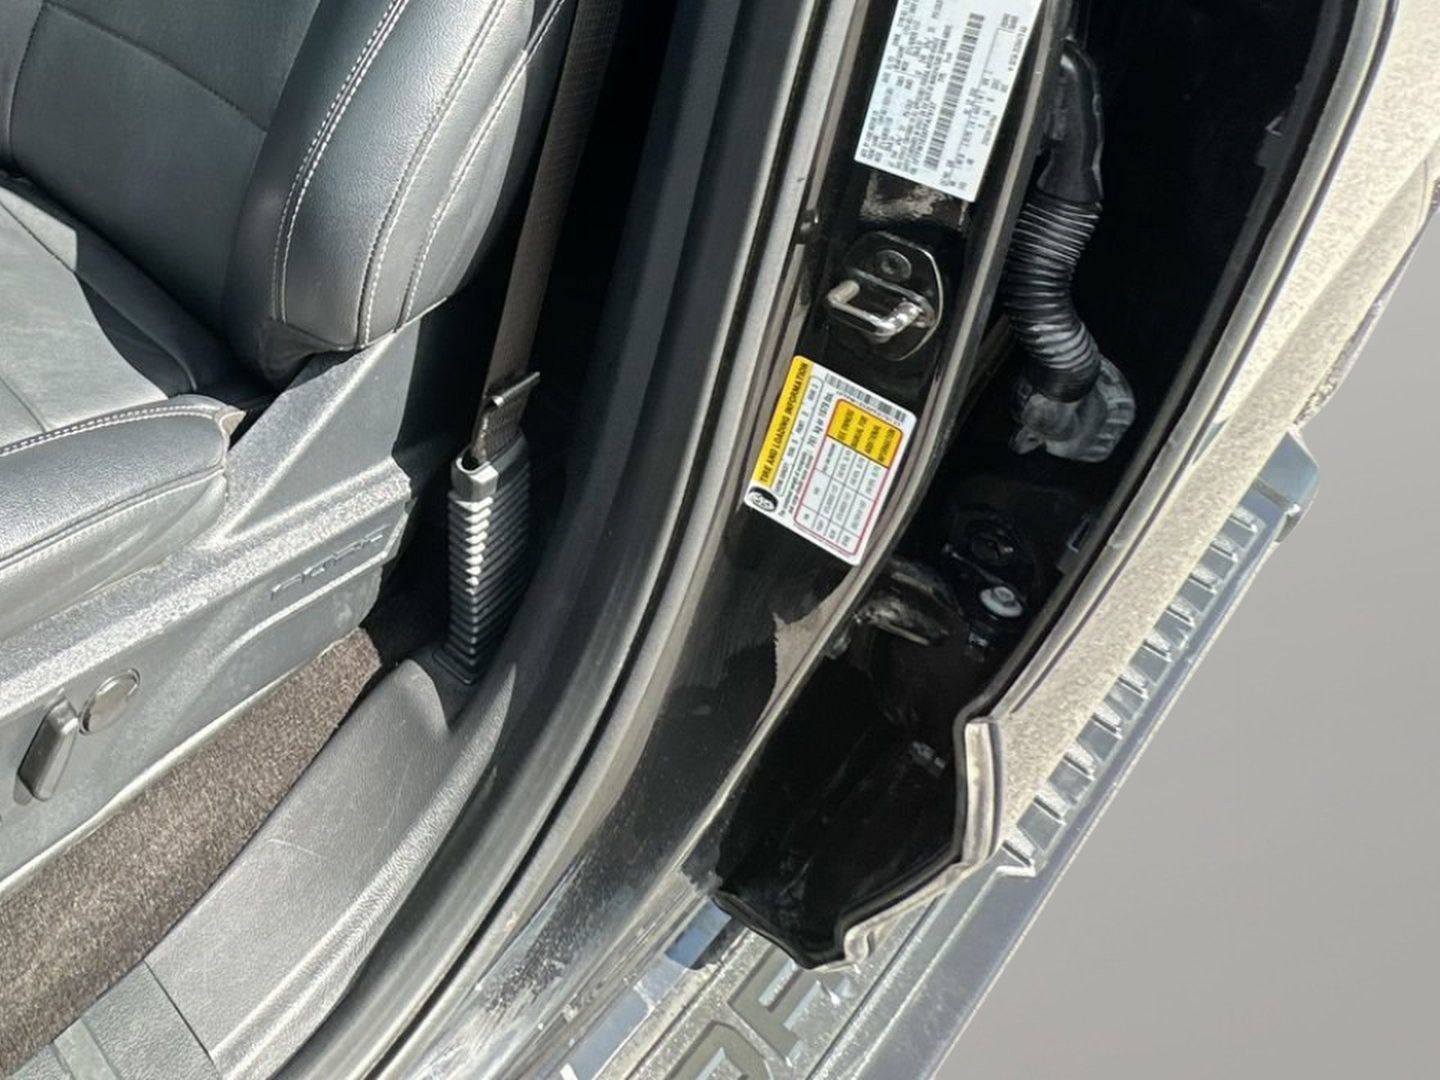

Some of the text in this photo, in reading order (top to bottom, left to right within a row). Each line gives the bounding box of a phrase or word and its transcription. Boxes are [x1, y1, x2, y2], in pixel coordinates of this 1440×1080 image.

[760, 362, 809, 482] TIRE AND LOADING INFORMATION
